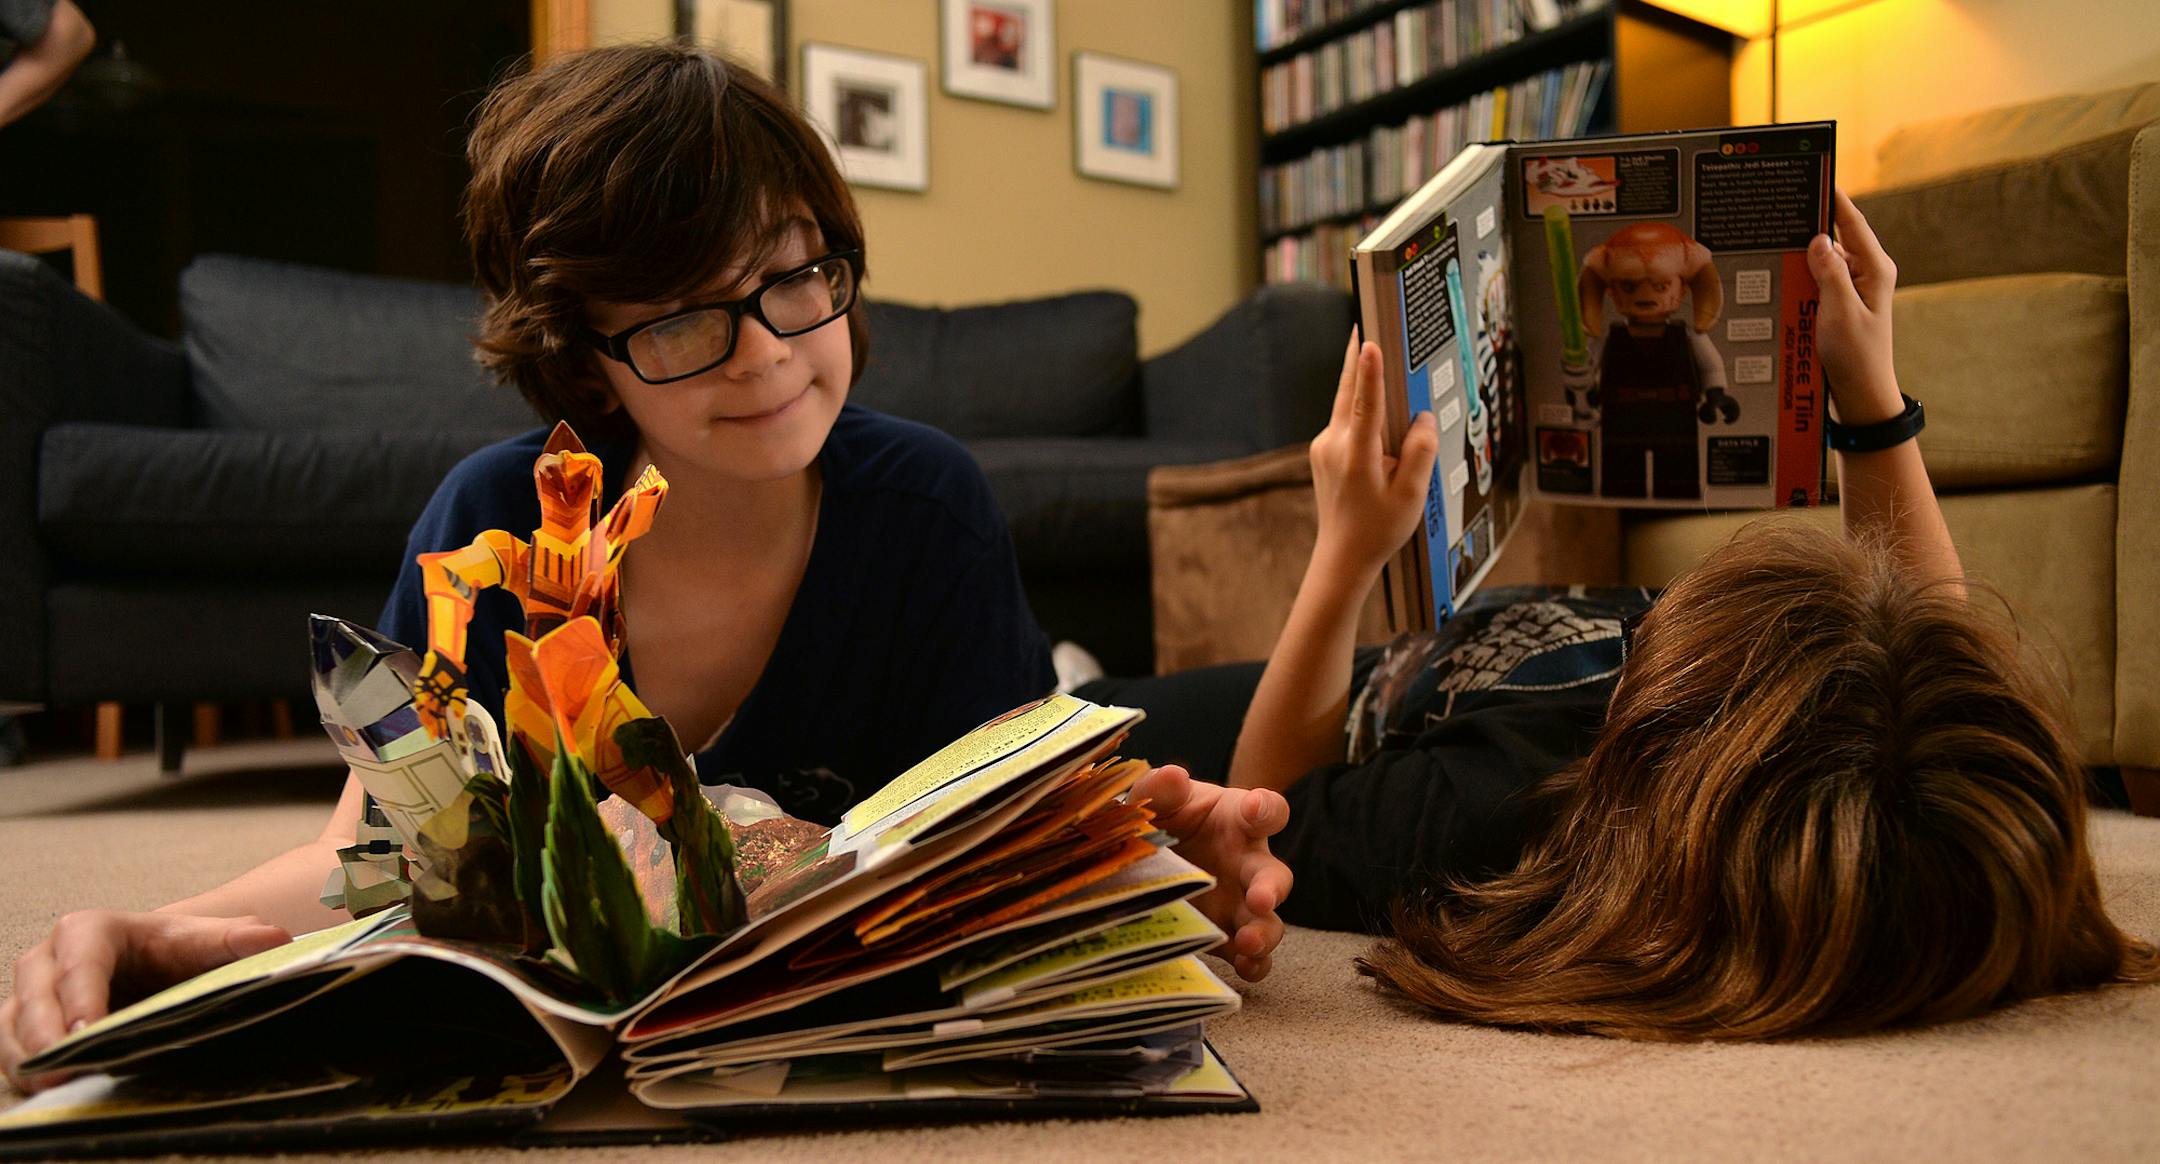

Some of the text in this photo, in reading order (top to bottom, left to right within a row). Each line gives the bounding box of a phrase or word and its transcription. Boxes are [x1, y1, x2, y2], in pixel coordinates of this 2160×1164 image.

[1743, 161, 1760, 169] Jedi
[1761, 160, 1789, 168] Saesee
[1795, 299, 1819, 432] Saesee Tiin
